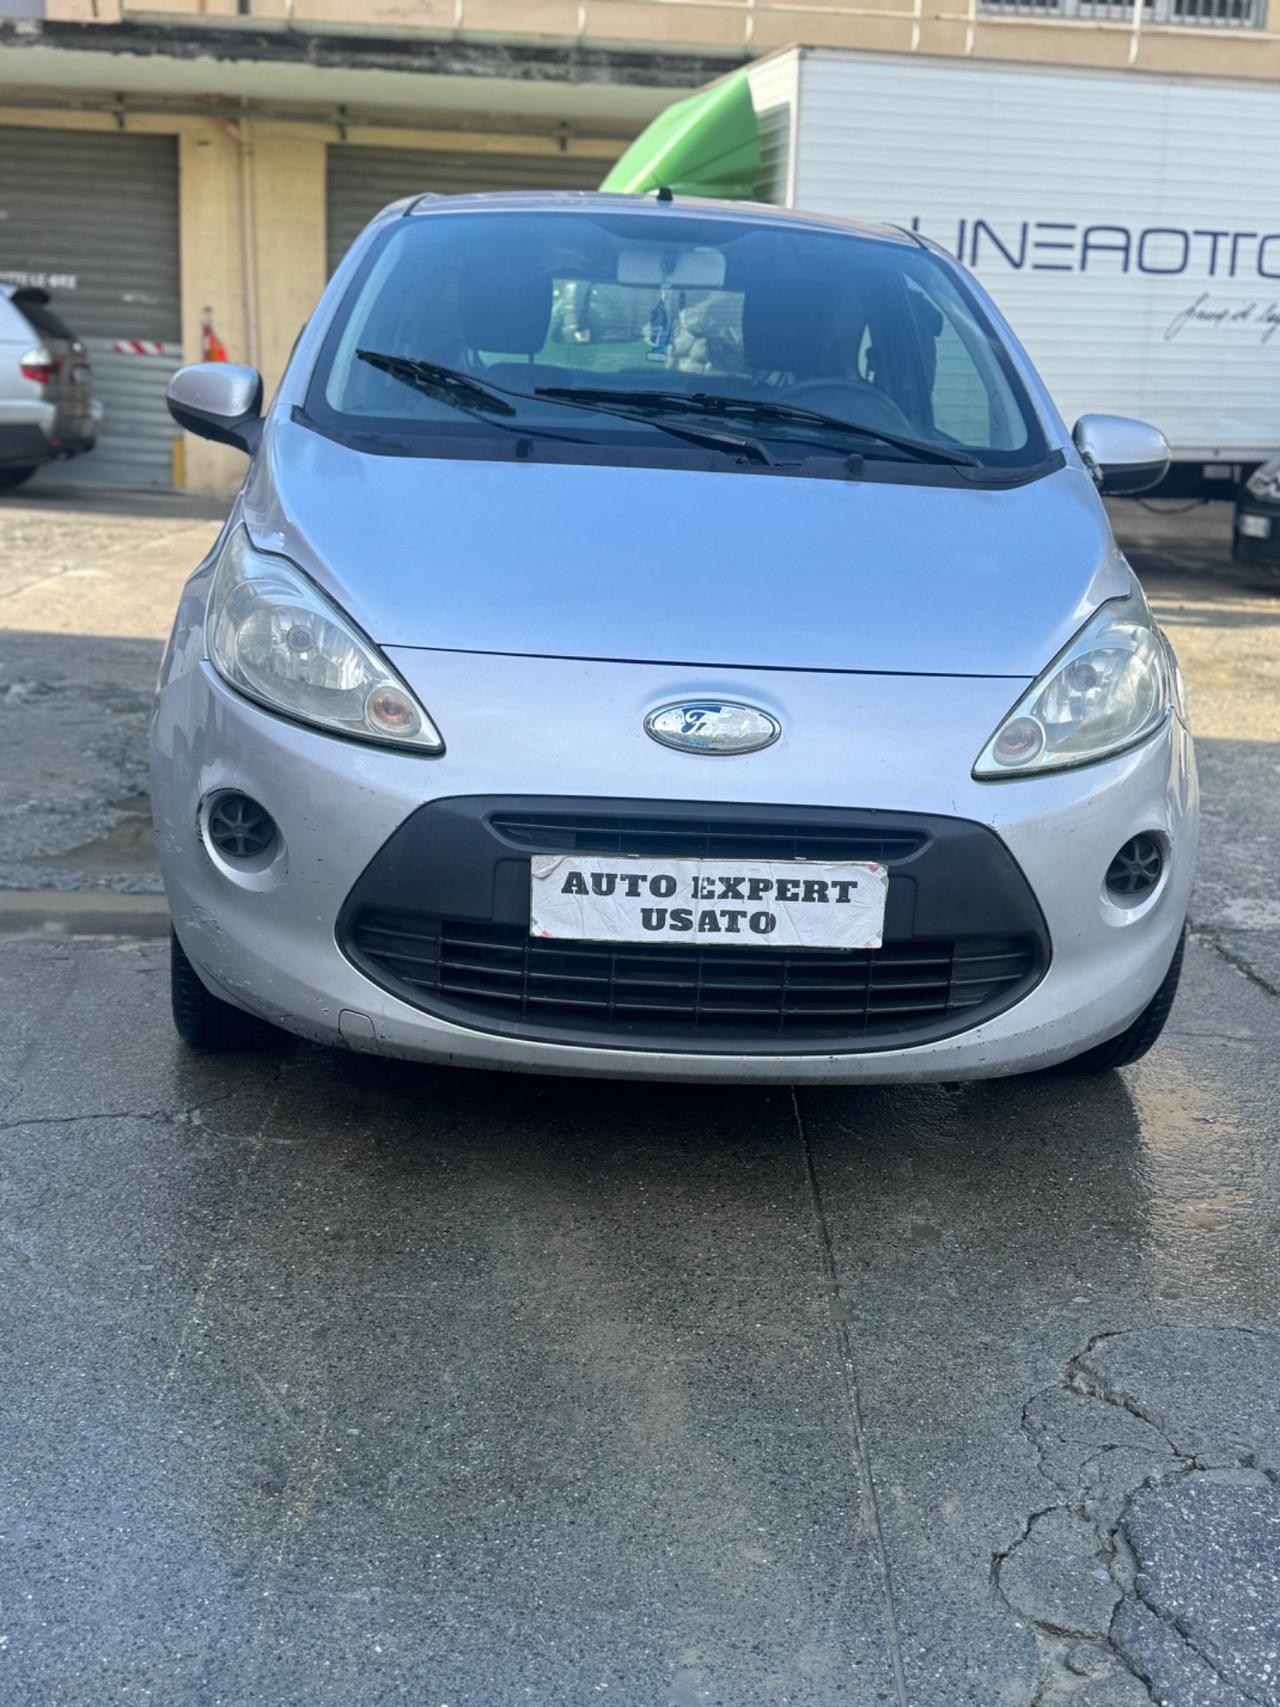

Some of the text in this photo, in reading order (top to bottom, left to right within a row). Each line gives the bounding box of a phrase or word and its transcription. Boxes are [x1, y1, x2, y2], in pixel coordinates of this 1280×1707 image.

[561, 871, 858, 903] AUTO EXPERT
[641, 908, 776, 934] USATO
